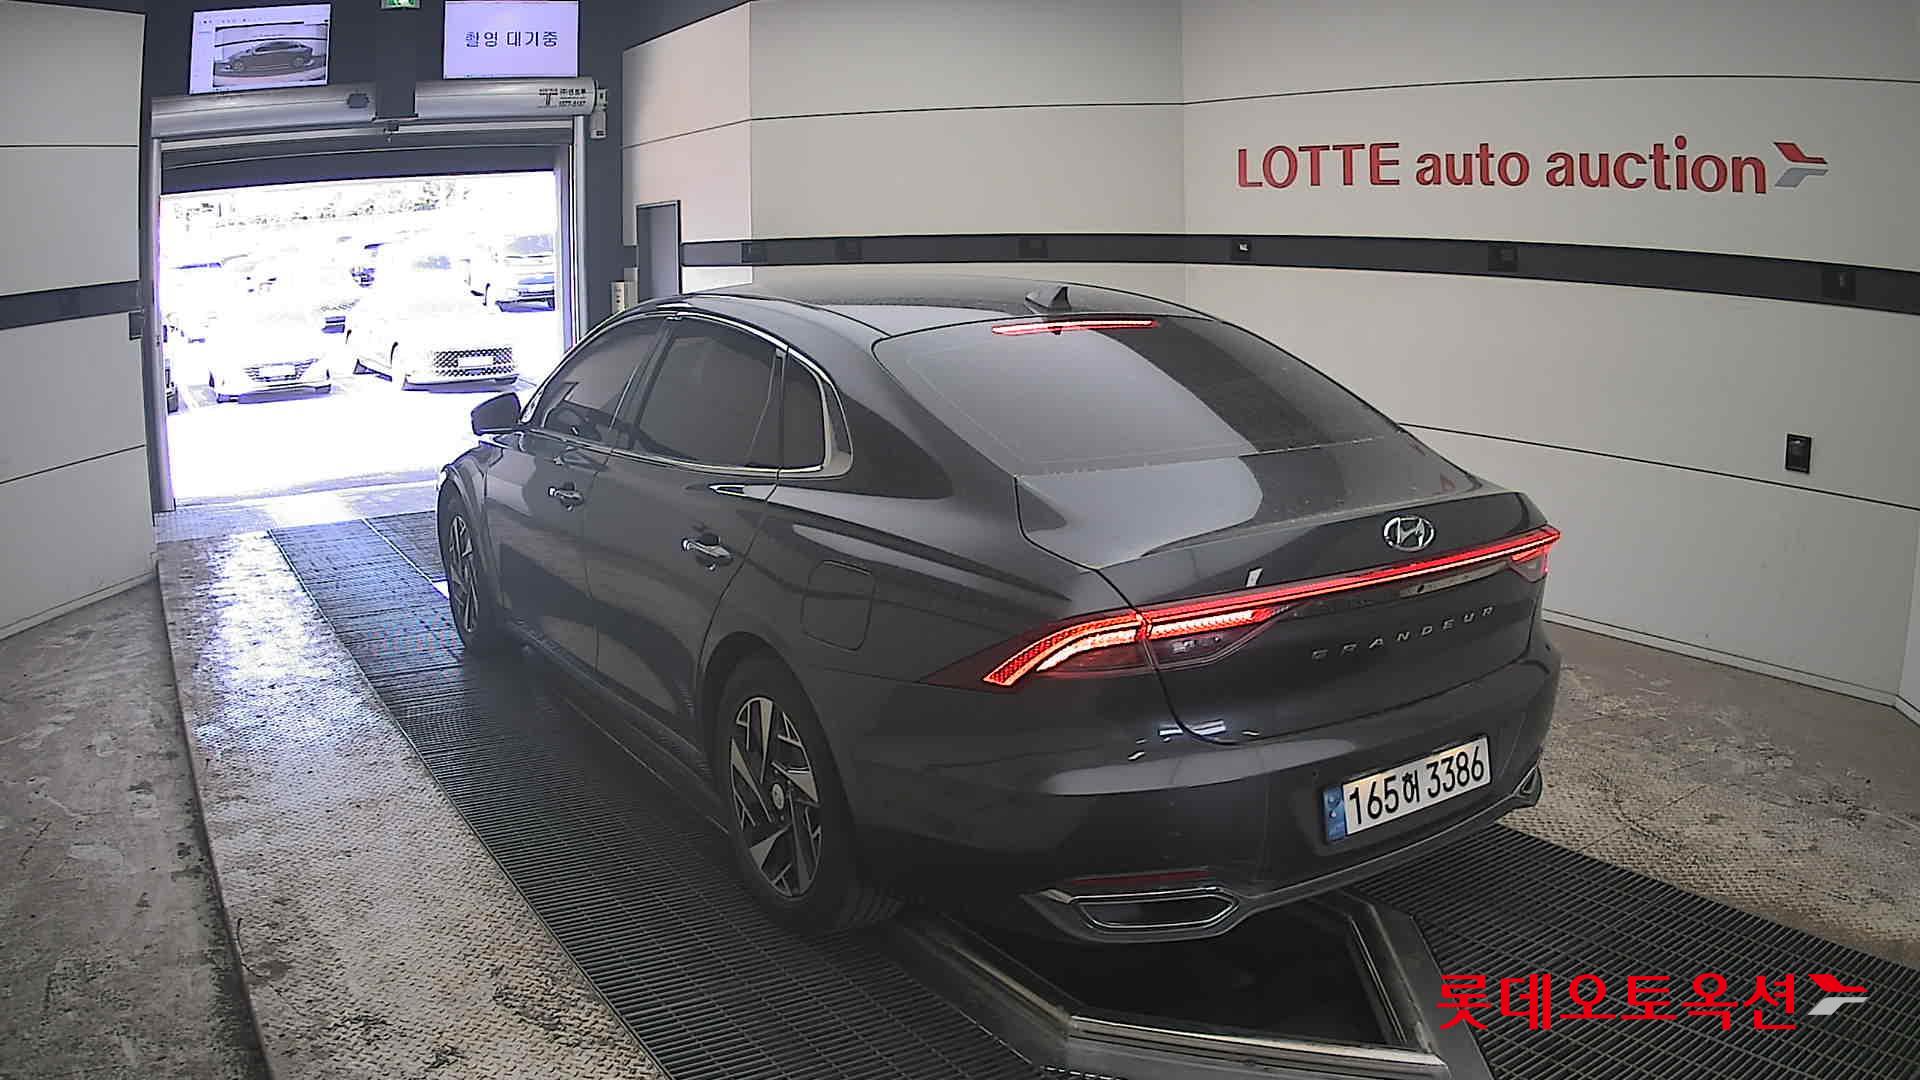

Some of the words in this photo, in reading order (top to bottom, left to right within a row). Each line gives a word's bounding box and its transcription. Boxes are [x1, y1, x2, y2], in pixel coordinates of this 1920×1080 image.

[506, 31, 558, 48] 대기중
[1237, 142, 1400, 188] LOTTE
[1414, 143, 1530, 187] auto
[1544, 135, 1768, 194] auction
[1311, 606, 1496, 660] GRANDEUR
